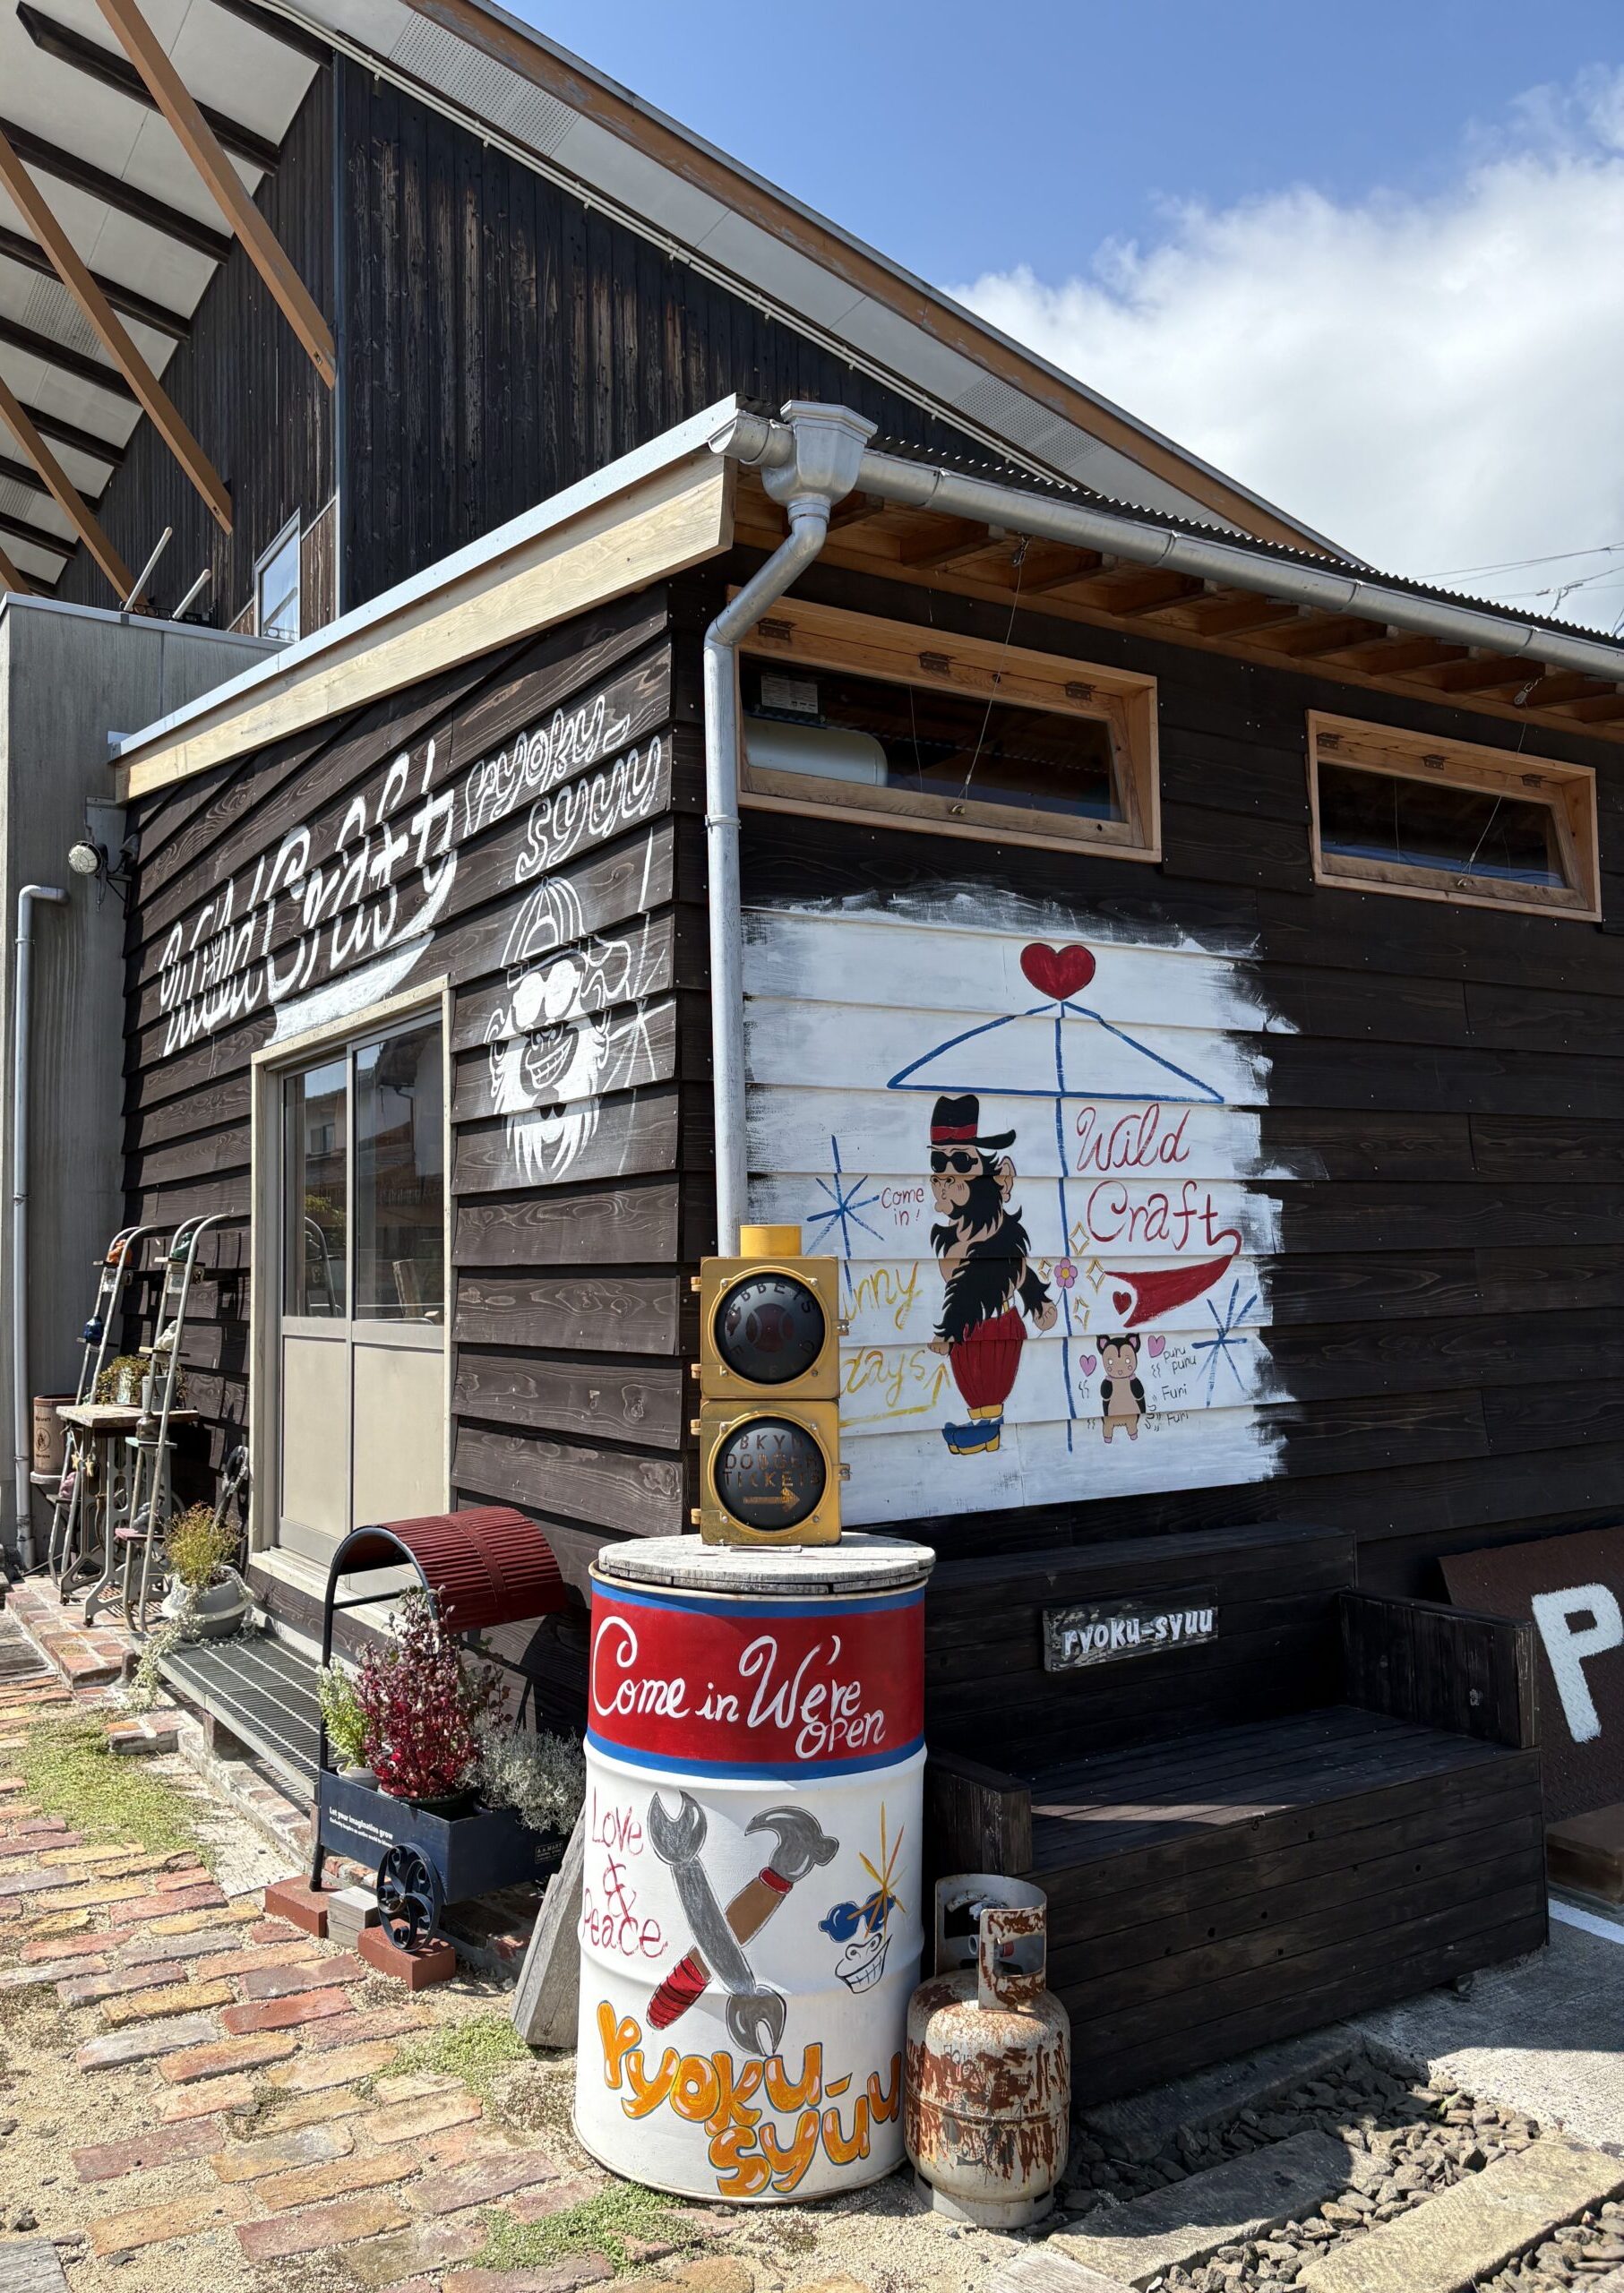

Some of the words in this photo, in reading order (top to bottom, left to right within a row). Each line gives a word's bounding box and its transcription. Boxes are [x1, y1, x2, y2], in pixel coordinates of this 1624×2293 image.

[159, 855, 265, 1057] Wild
[262, 740, 457, 1004] Craft
[1076, 1103, 1191, 1172] Wild
[1087, 1180, 1231, 1252] Craft
[1060, 1609, 1213, 1656] ryoku-syuu
[1531, 1583, 1624, 1743] P
[593, 1616, 690, 1716] Come
[694, 1682, 739, 1722] in
[591, 1786, 644, 1856] Love
[582, 1887, 668, 1958] Peace
